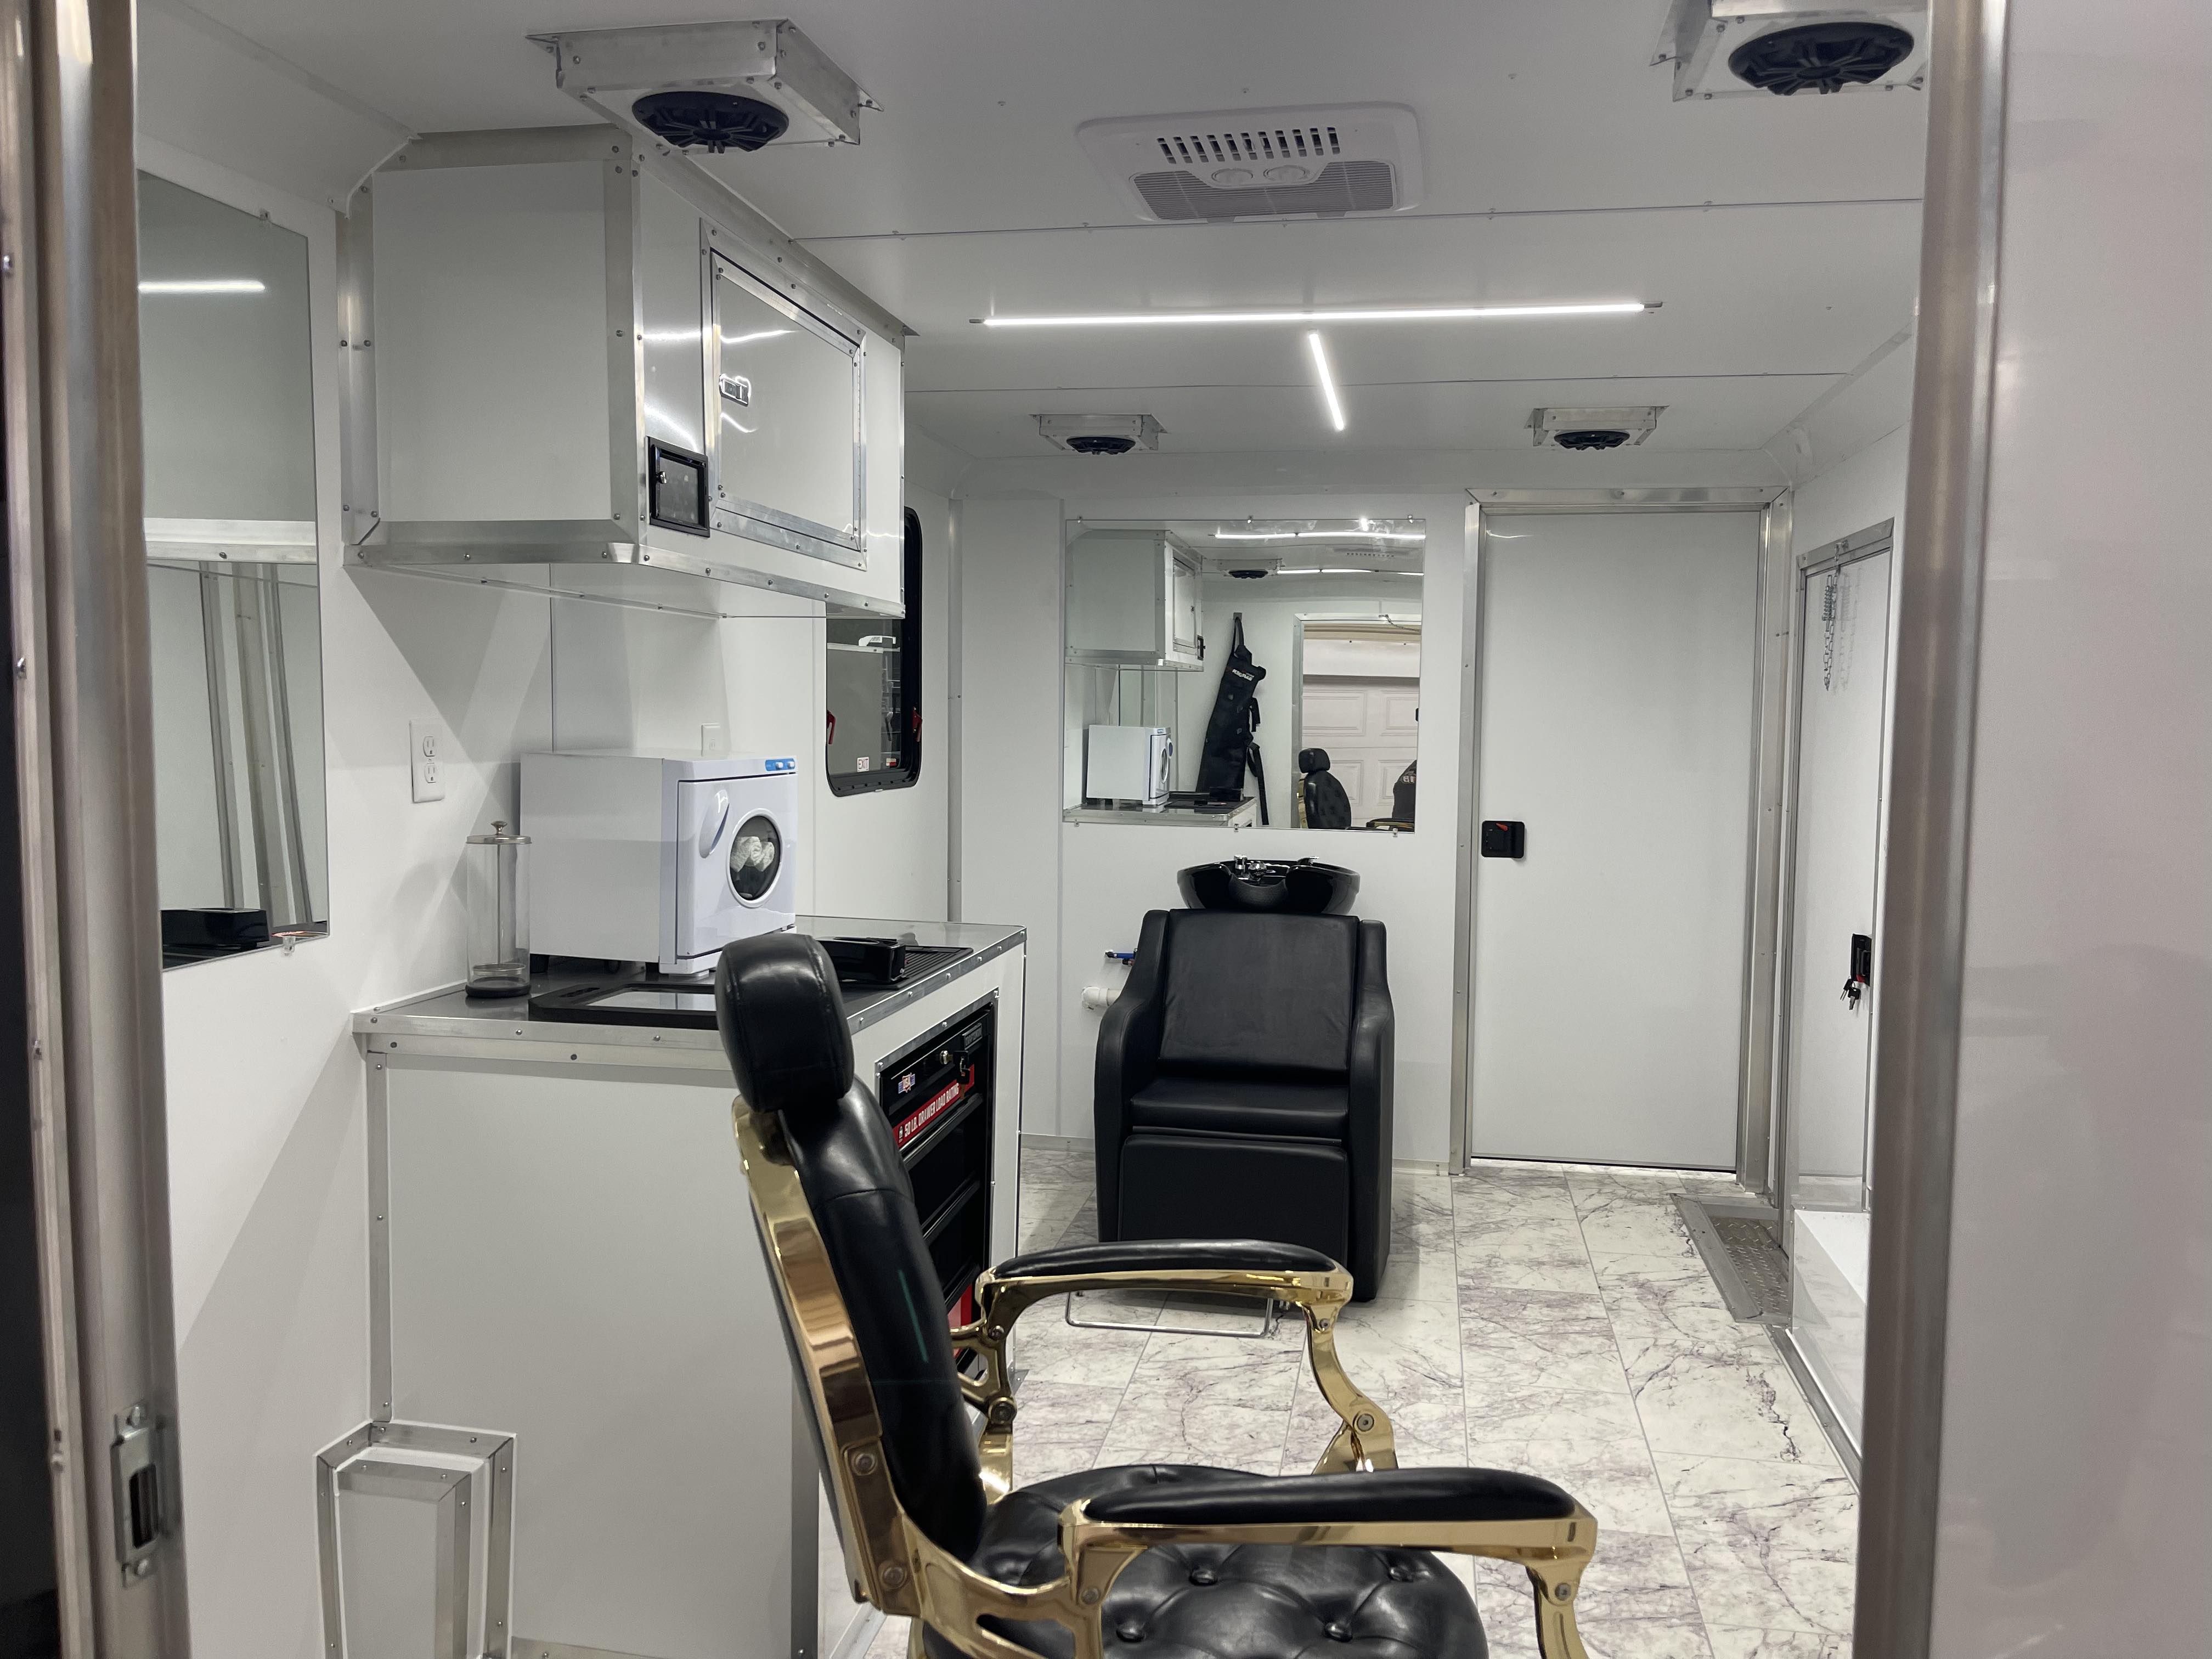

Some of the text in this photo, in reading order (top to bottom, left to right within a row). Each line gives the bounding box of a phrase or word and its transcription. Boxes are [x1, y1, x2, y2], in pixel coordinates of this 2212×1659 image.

[859, 758, 868, 769] EXIT
[905, 1121, 911, 1137] 50
[918, 1101, 935, 1126] DRAWER
[936, 1093, 946, 1111] LOAD
[946, 1082, 959, 1103] RATING
